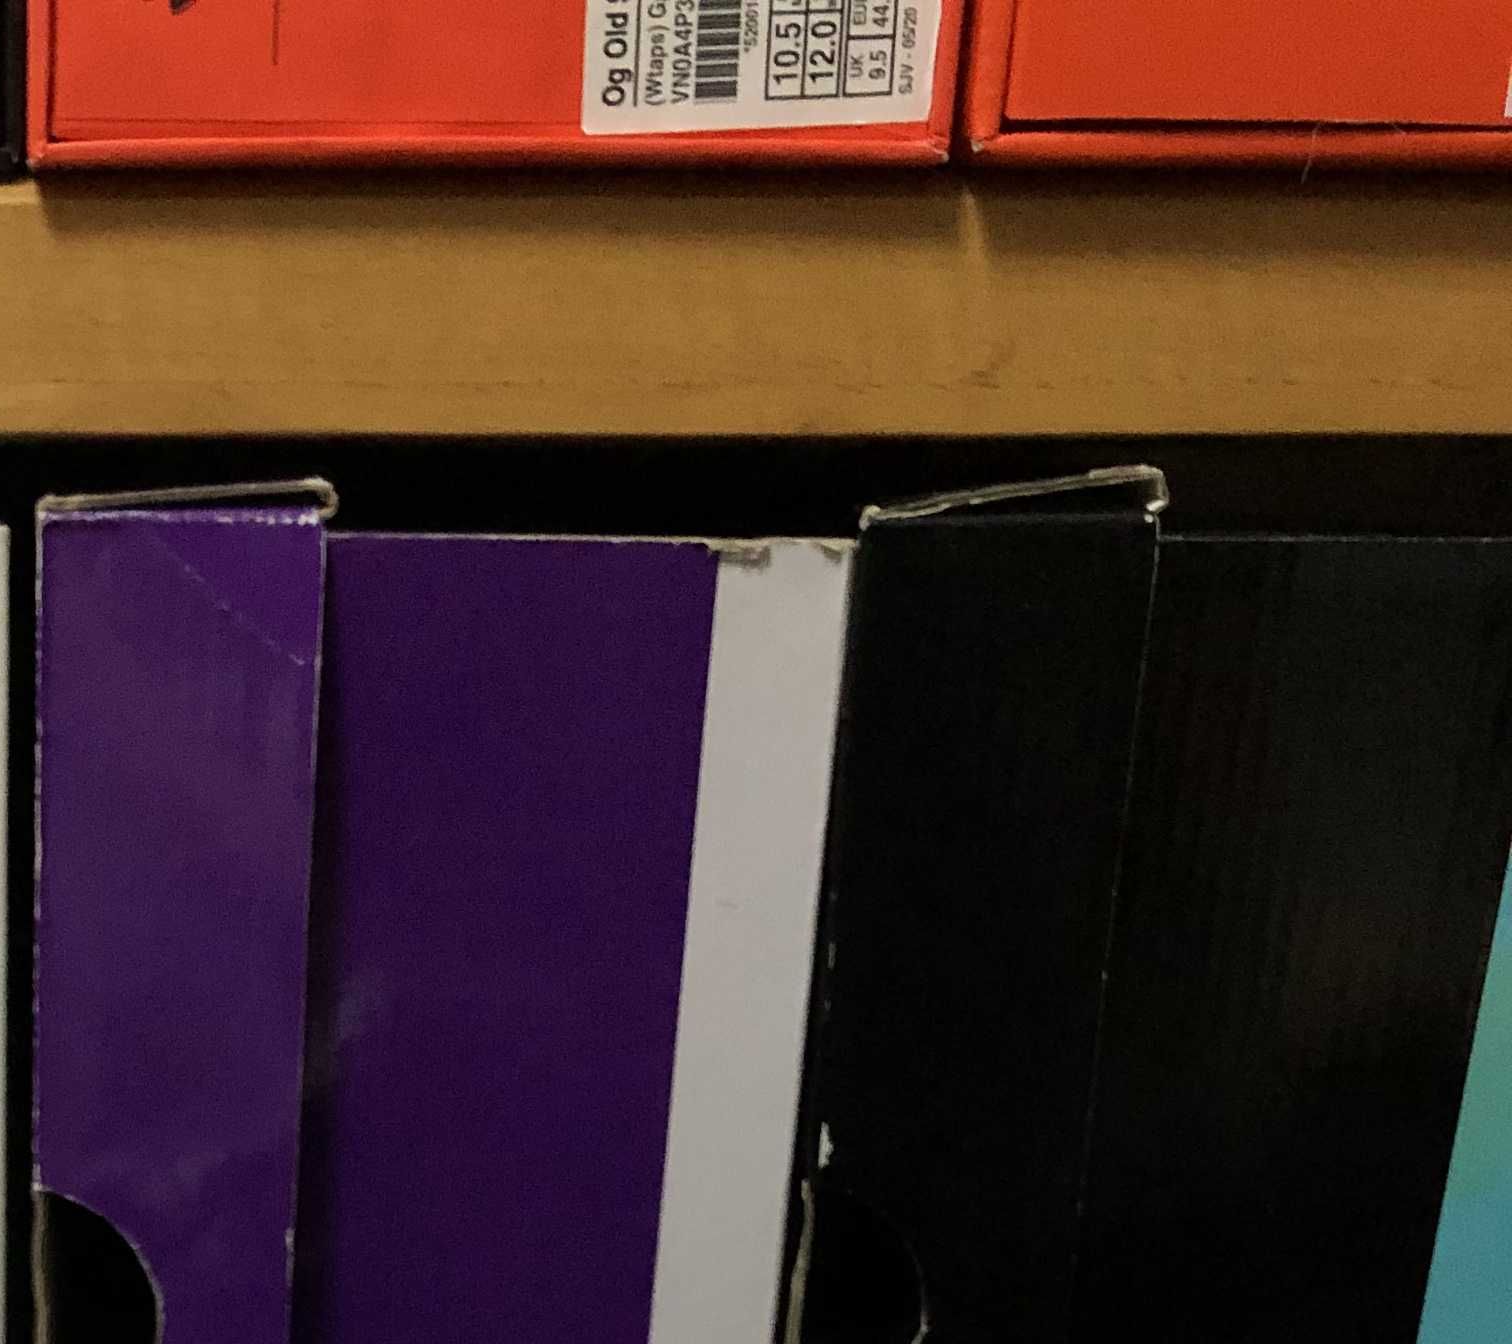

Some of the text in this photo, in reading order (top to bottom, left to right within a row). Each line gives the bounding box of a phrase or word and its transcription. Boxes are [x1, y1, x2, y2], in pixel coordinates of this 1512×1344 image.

[603, 13, 629, 58] Old
[773, 23, 802, 84] 10.5
[808, 21, 837, 82] 12.0
[602, 68, 632, 106] Og
[645, 25, 670, 105] (Wtaps)
[850, 53, 864, 78] UK
[869, 50, 887, 79] 9.5
